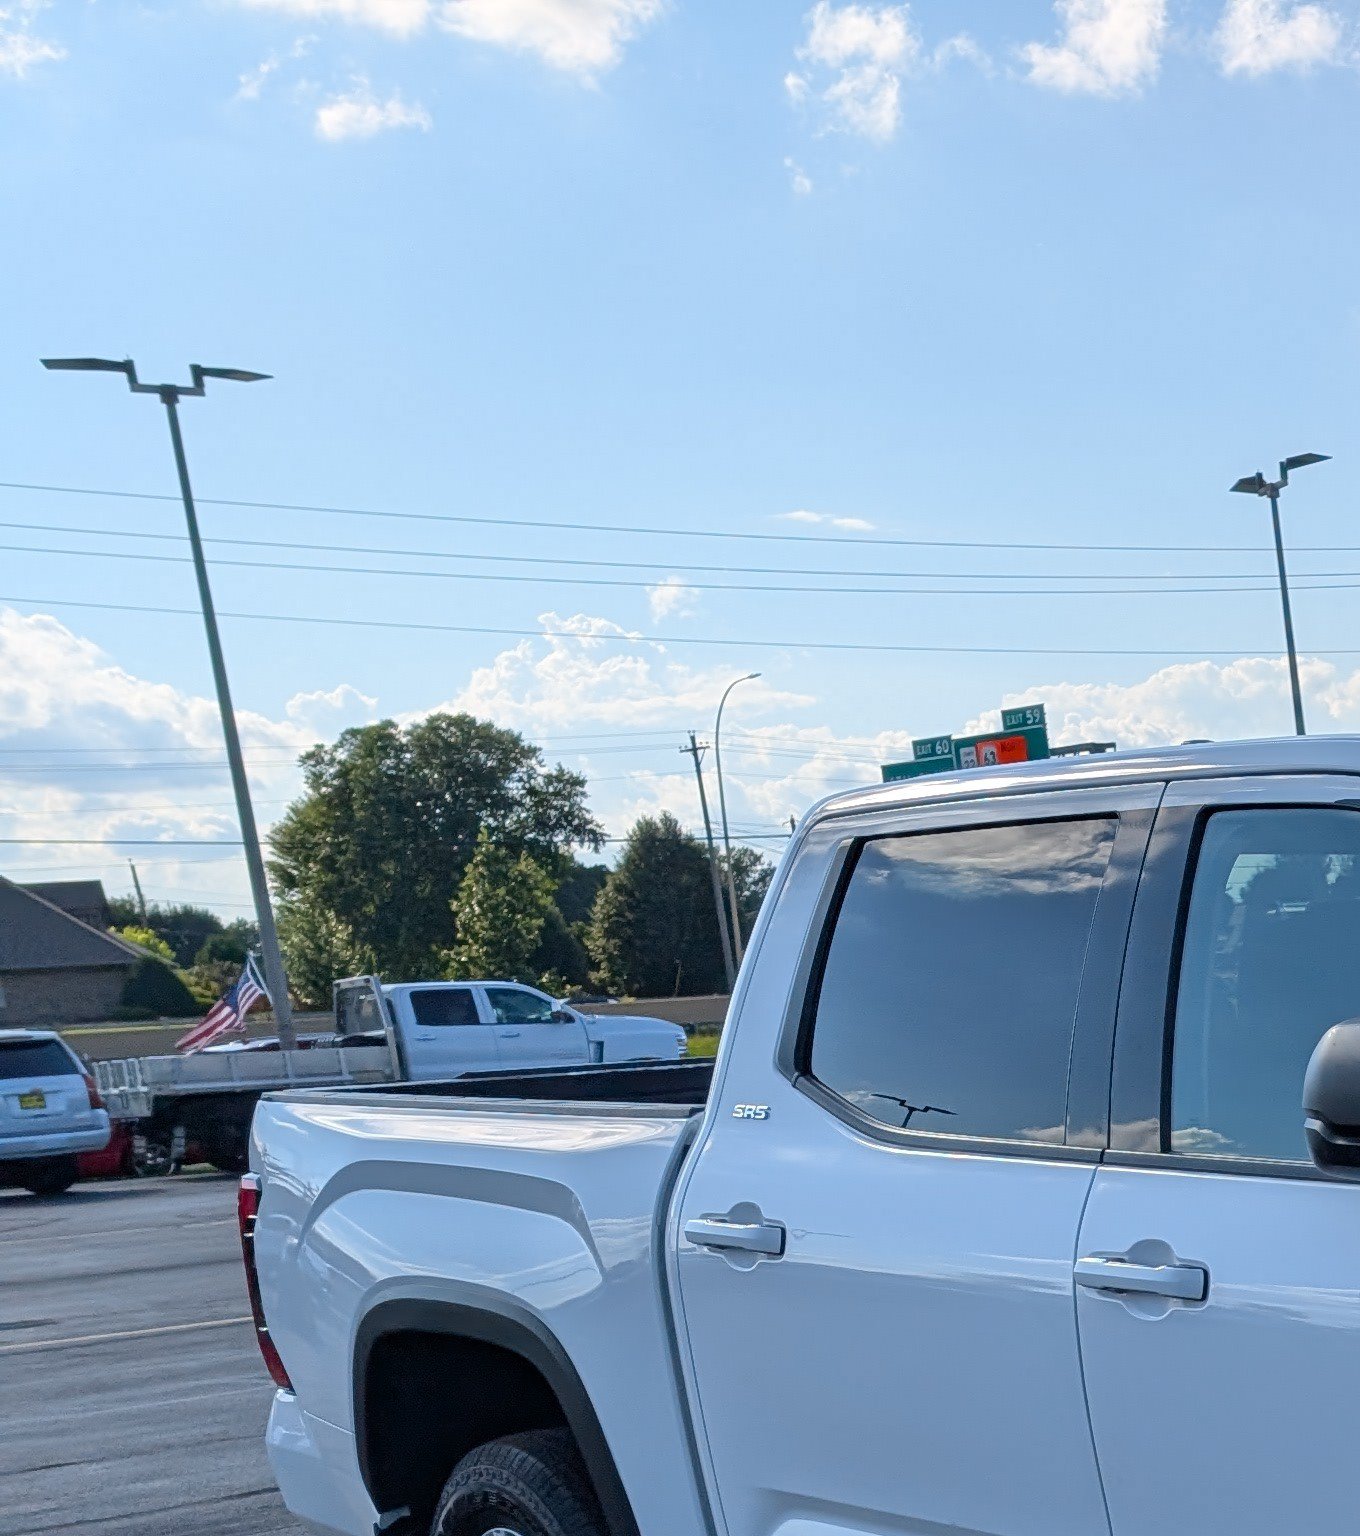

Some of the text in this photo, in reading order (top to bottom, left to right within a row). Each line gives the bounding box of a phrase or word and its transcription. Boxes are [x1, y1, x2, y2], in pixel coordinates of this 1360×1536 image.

[1025, 708, 1041, 725] 59
[935, 739, 950, 754] 60
[732, 1104, 770, 1120] SR5
